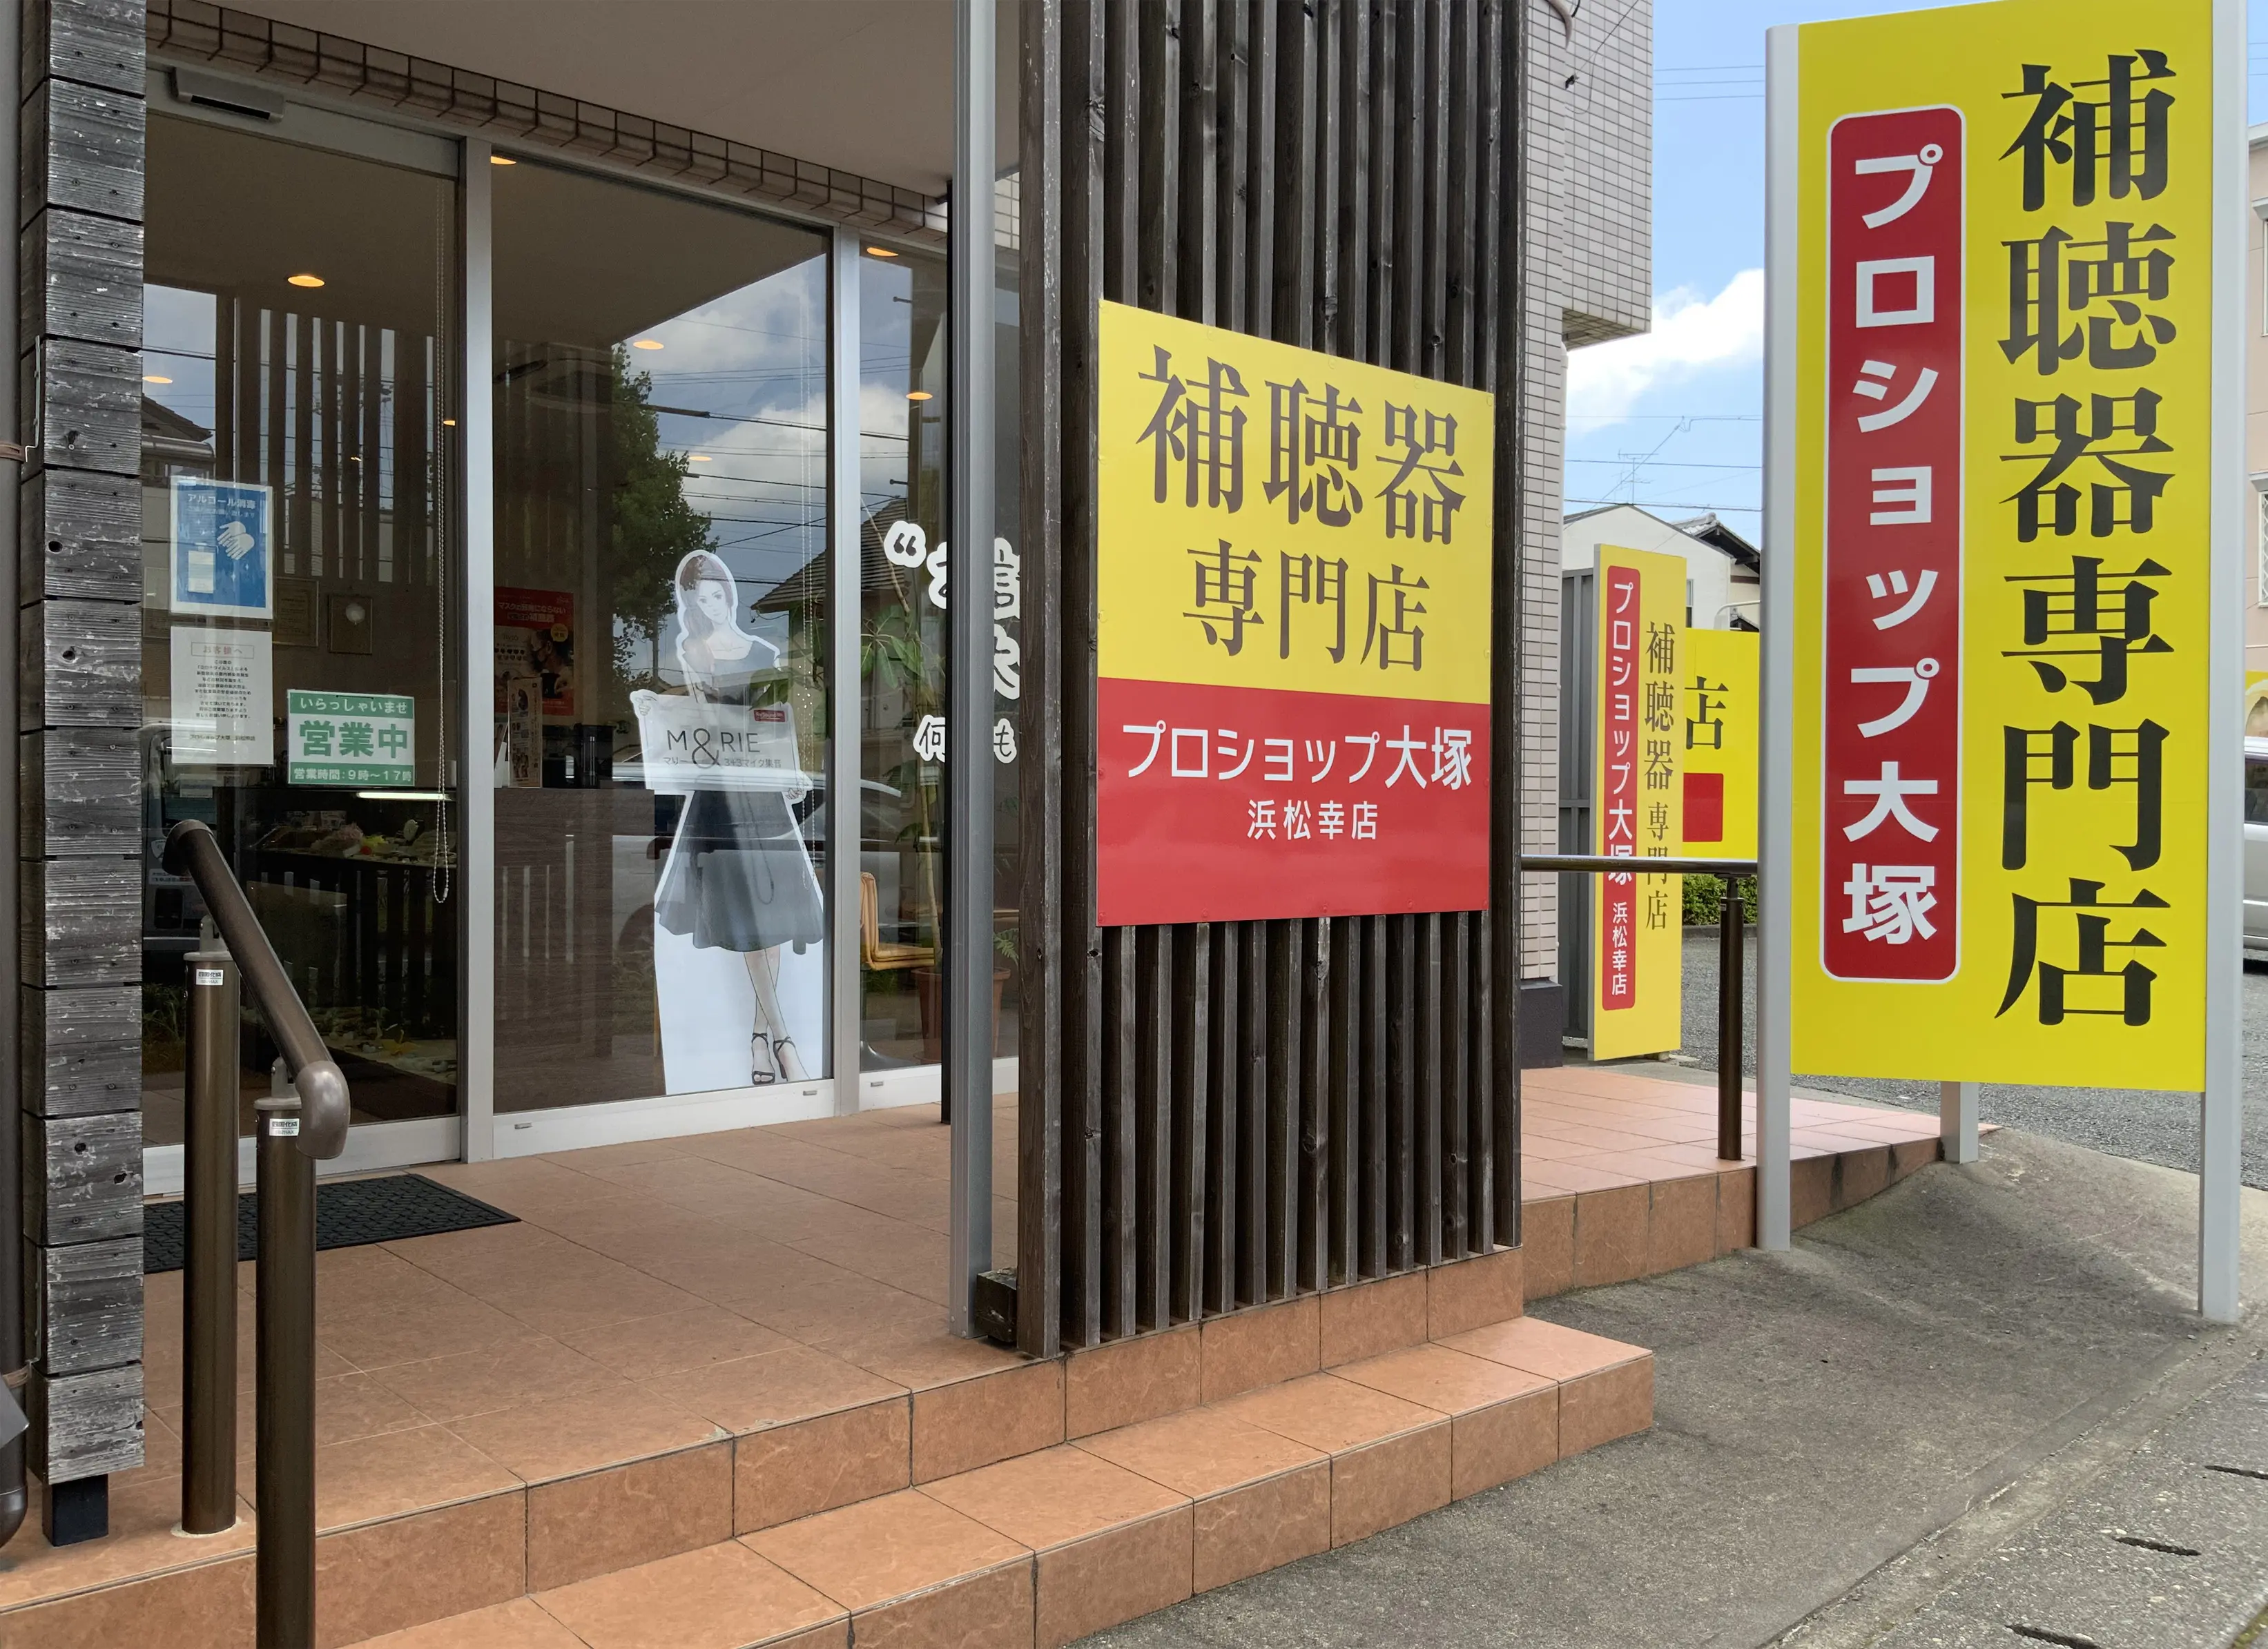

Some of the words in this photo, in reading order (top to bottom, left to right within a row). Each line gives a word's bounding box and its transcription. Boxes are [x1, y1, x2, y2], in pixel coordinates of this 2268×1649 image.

[1136, 344, 1466, 545] 補聴器
[1842, 144, 1942, 944] プロショップ大塚
[1994, 48, 2178, 1026] 補聴器専門店
[1183, 539, 1431, 672] 専門店
[300, 697, 407, 714] いらっしゃいませ
[300, 719, 408, 759] 営業中
[1123, 720, 1472, 791] プロショップ大塚
[1608, 582, 1634, 886] プロショップ大塚
[1247, 799, 1378, 841] 浜松幸店
[1611, 901, 1628, 996] 浜松幸店
